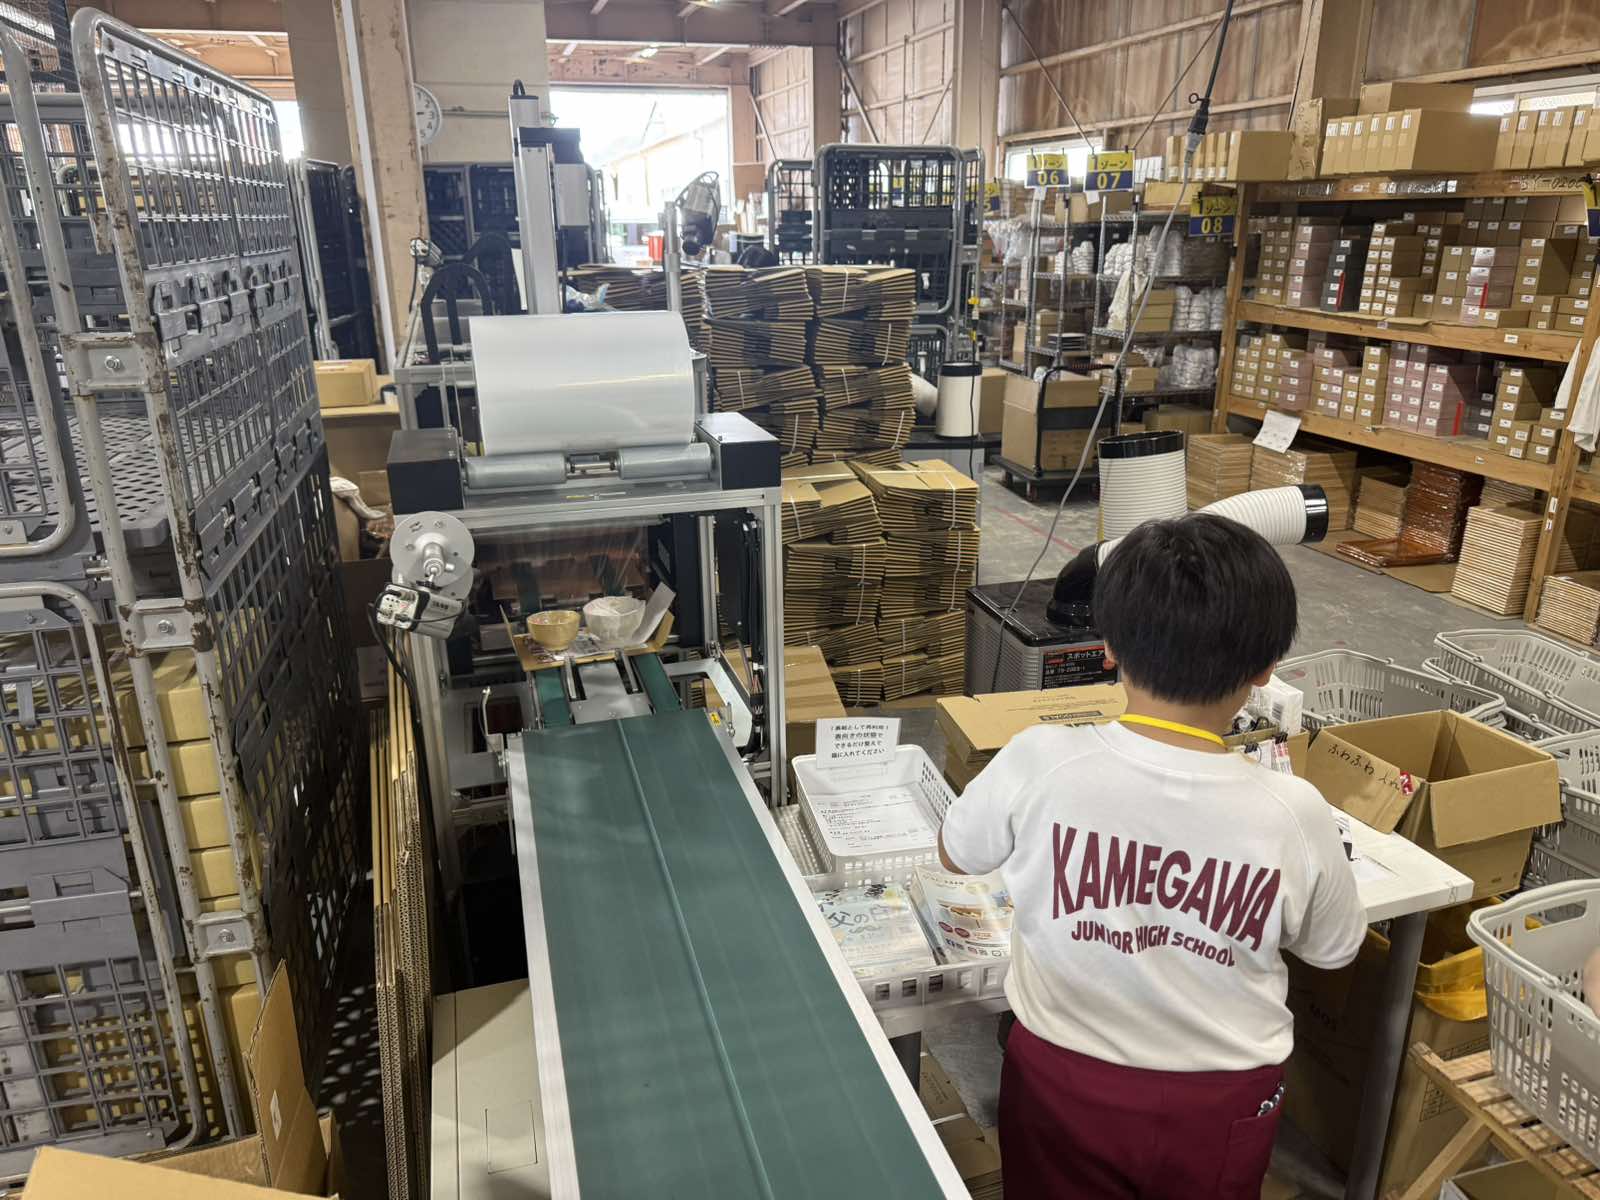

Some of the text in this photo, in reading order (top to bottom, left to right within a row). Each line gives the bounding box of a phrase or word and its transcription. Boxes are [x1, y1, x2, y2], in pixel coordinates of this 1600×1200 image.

[1038, 170, 1060, 186] 06
[1097, 172, 1122, 189] 07
[1201, 217, 1223, 234] 08
[1052, 822, 1281, 952] KAMEGAWA
[1071, 920, 1236, 968] JUNIOR HIGH SCHOOL
